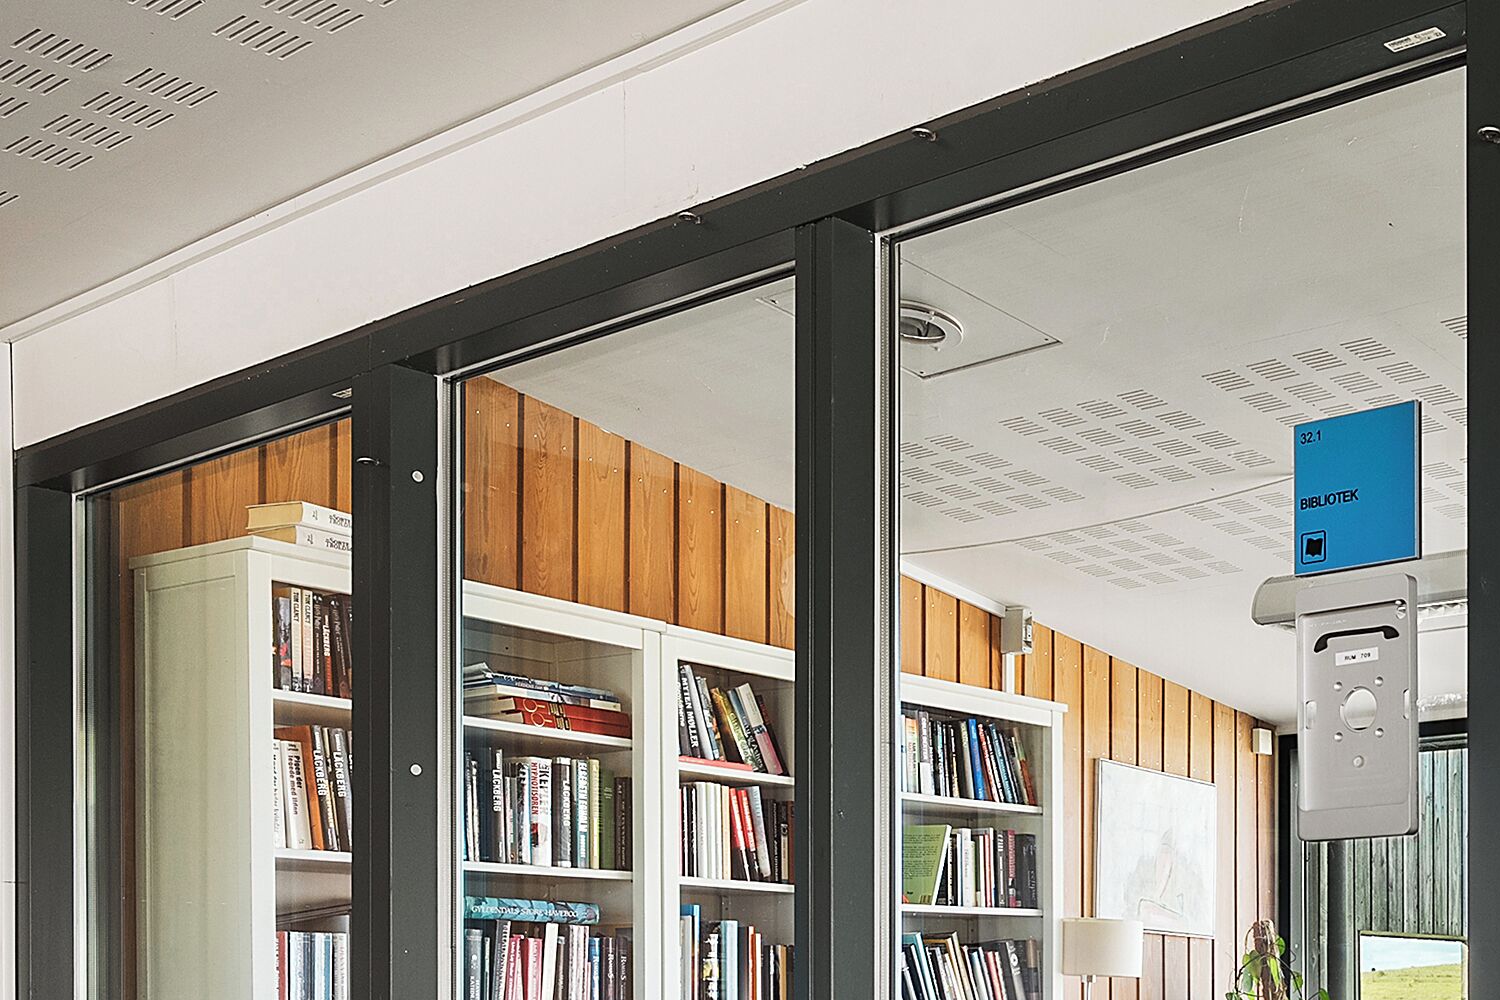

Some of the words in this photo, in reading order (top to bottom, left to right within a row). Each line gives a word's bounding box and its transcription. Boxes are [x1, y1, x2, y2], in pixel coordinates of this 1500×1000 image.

[1300, 430, 1322, 445] 32.1
[1300, 489, 1359, 510] BIBLIOTEK
[682, 678, 692, 709] MYTEN
[688, 711, 698, 747] MØLLER
[752, 744, 763, 768] Ashes
[531, 762, 539, 815] HYPNOTISØREN
